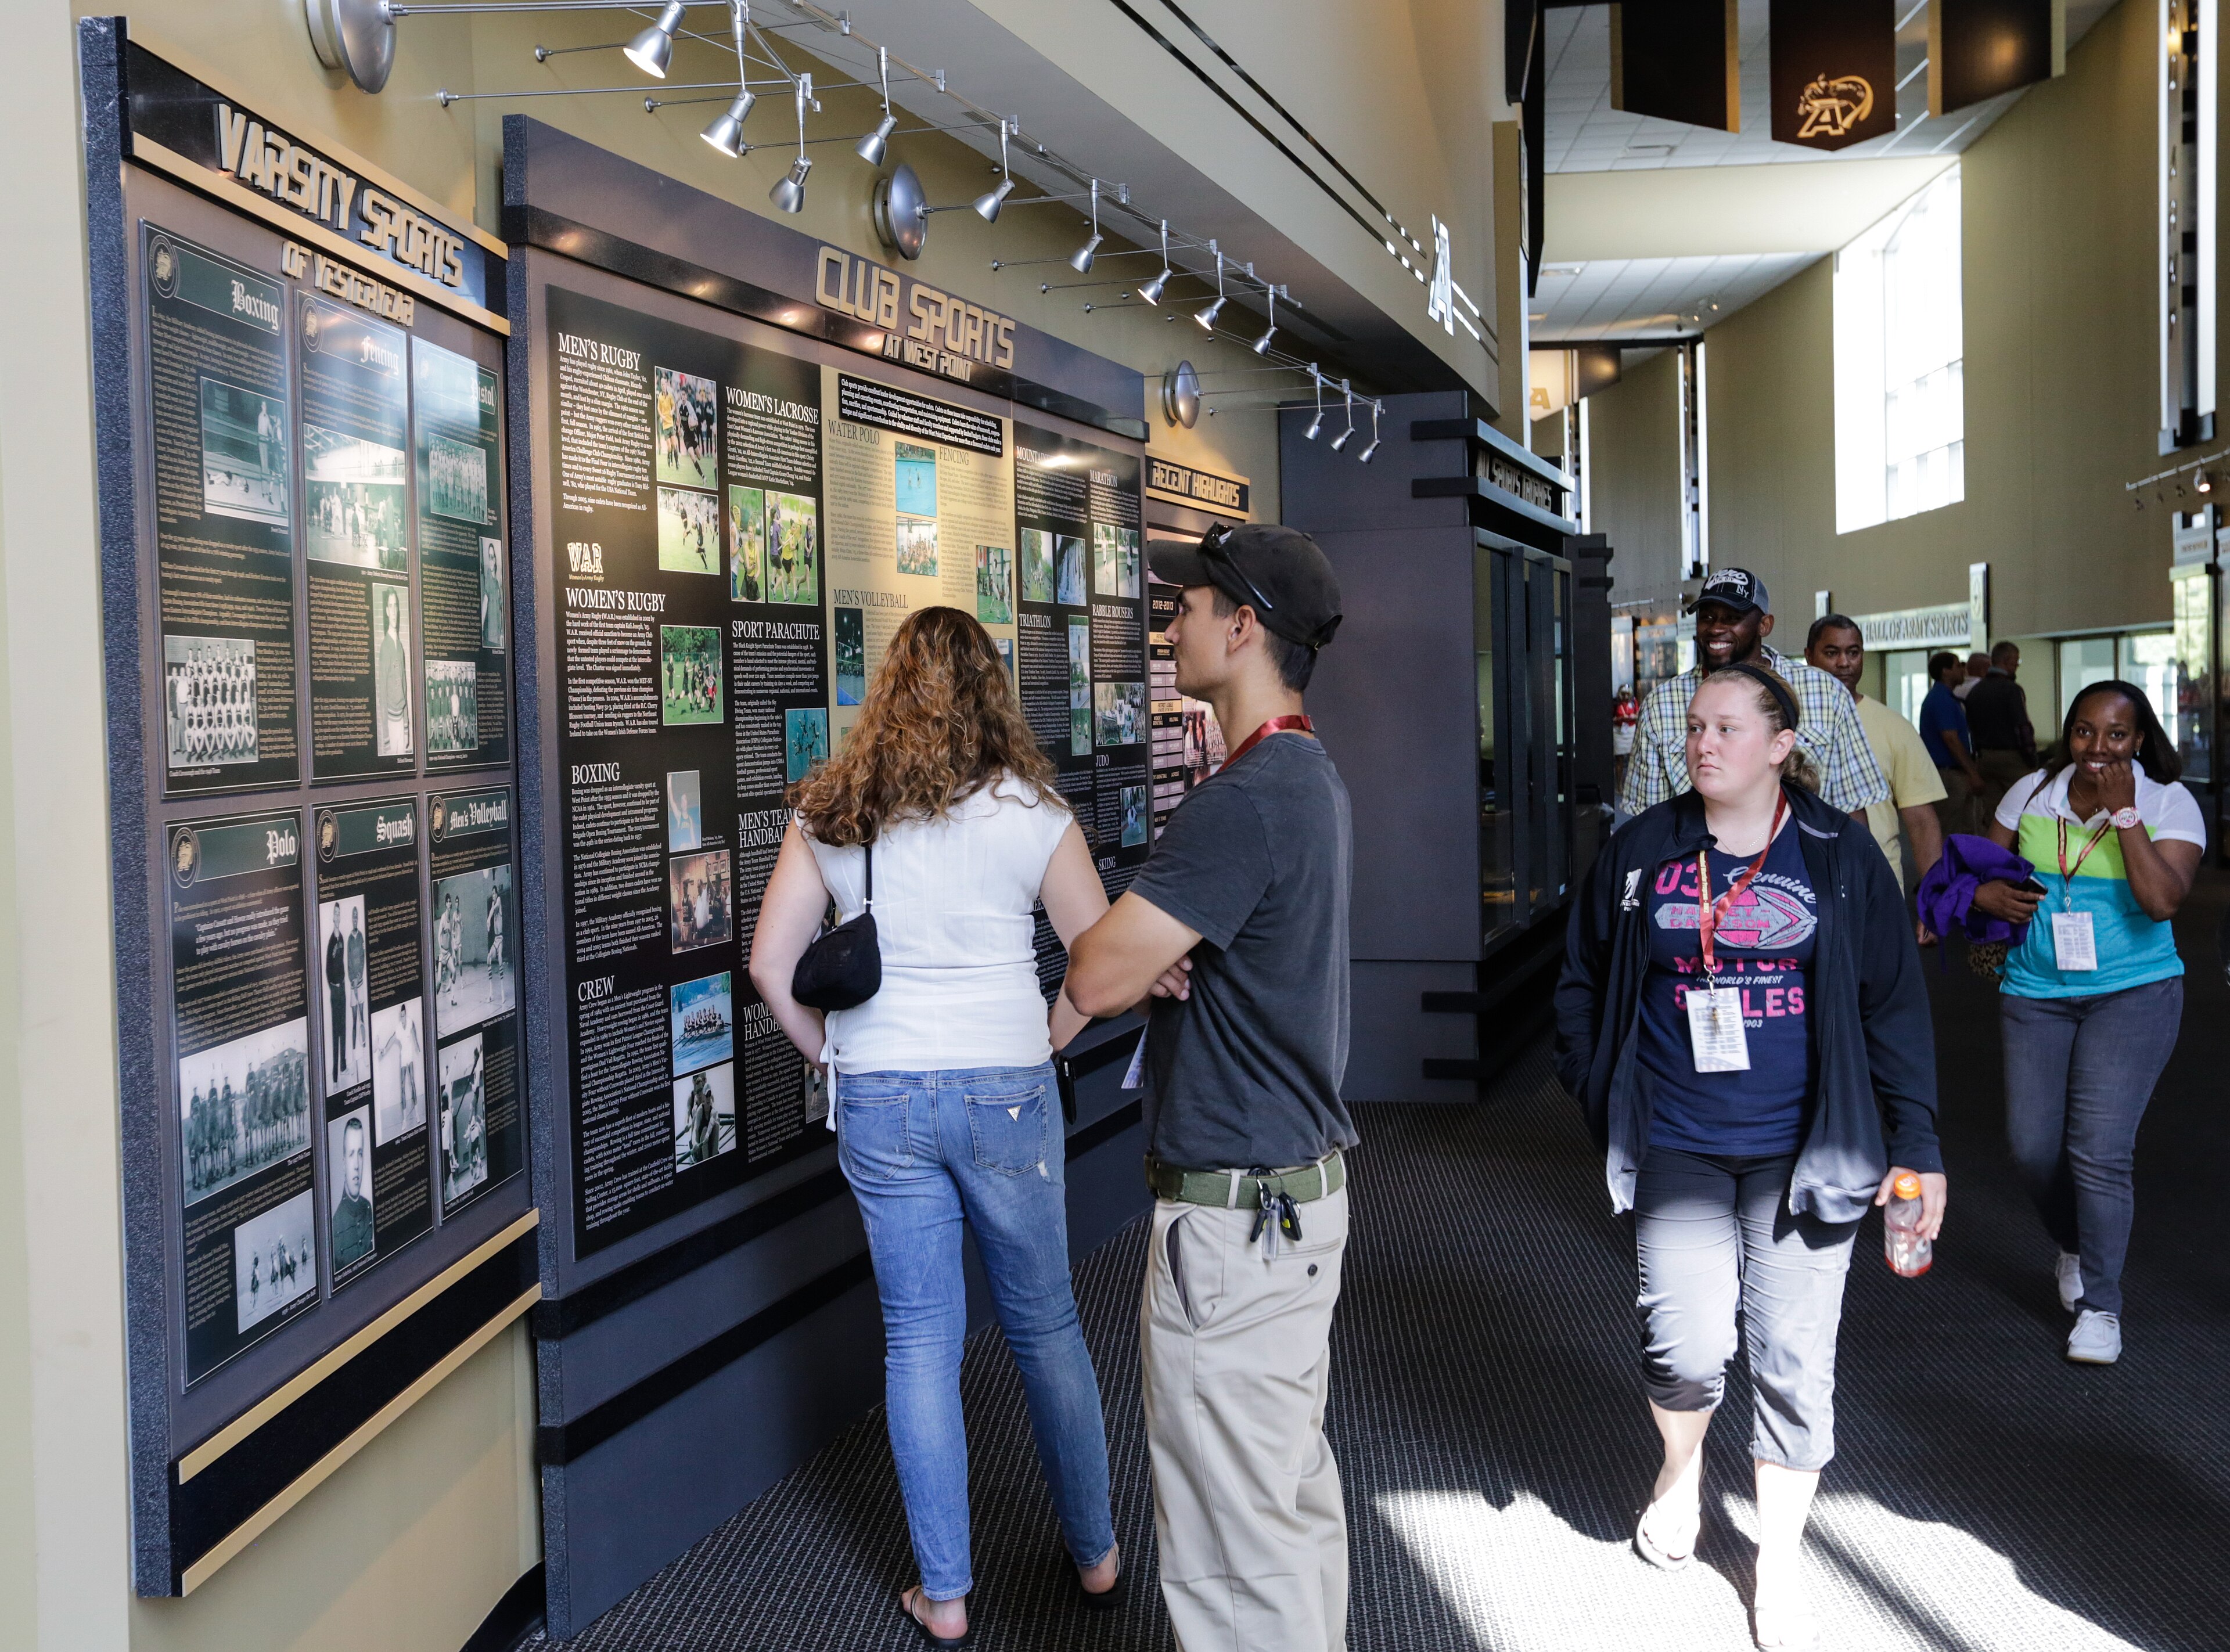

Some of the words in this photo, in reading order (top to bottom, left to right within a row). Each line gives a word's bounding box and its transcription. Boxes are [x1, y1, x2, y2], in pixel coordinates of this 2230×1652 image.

[215, 103, 356, 230] VARSITY
[359, 189, 463, 287] SPORTS
[282, 241, 311, 279] OF
[312, 253, 413, 326] YESTERYEAR
[232, 279, 279, 330] Boxing
[816, 246, 900, 329] CLUB
[908, 283, 1016, 369] SPORTS
[361, 335, 400, 375] Fencing
[558, 332, 598, 360] MEN'S
[600, 343, 641, 371] RUGBY
[883, 334, 902, 359] AT
[903, 339, 939, 371] WEST
[940, 351, 973, 382] POINT
[559, 355, 569, 364] Army
[576, 359, 587, 368] played
[587, 362, 596, 370] rugby
[631, 372, 641, 381] Taylor,
[470, 377, 495, 408] Pistol
[726, 386, 772, 413] WOMEN'S
[774, 398, 819, 425] LACROSSE
[828, 419, 858, 440] WATER
[859, 428, 880, 445] POLO
[938, 446, 969, 465] FENCING
[1090, 469, 1117, 487] MARATHON
[1152, 461, 1191, 494] RECENT
[1191, 472, 1240, 508] HIGHLIGHTS
[563, 492, 577, 502] Through
[621, 501, 637, 510] recognized
[567, 542, 603, 573] WAR
[566, 588, 625, 610] WOMEN'S
[627, 592, 666, 611] RUGBY
[834, 589, 859, 605] MEN'S
[860, 591, 908, 609] VOLLEYBALL
[1092, 604, 1111, 617] RABBLE
[1112, 606, 1134, 619] ROUSERS
[1153, 600, 1174, 611] 2012-2013
[732, 620, 764, 638] SPORT
[765, 622, 819, 640] PARACHUTE
[1019, 613, 1051, 628] TRIATHLON
[1866, 620, 1887, 643] HALL
[1890, 618, 1901, 640] OF
[1903, 615, 1929, 639] ARMY
[1930, 611, 1968, 637] SPORTS
[571, 762, 620, 784] BOXING
[1096, 754, 1109, 766] JUDO
[450, 809, 468, 831] Men's
[469, 799, 507, 827] Volleyball
[738, 810, 769, 830] MEN'S
[376, 814, 412, 844] Squash
[267, 829, 296, 864] Polo
[1099, 856, 1116, 871] SKIING
[1723, 866, 1817, 904] Genuine
[1670, 918, 1771, 929] DADSON
[1671, 906, 1771, 917] HAEY-
[578, 976, 615, 1002] CREW
[1714, 976, 1752, 985] WORLD'S
[1753, 975, 1783, 985] FINEST
[579, 1010, 589, 1020] spring
[614, 1001, 625, 1010] ancient
[633, 995, 648, 1006] purchased
[1675, 984, 1805, 1017] CLES
[585, 1186, 594, 1194] Since
[595, 1183, 603, 1192] 2002,
[604, 1178, 613, 1188] Army
[613, 1174, 621, 1183] Crew
[628, 1167, 638, 1177] trained
[648, 1158, 660, 1168] Caufield
